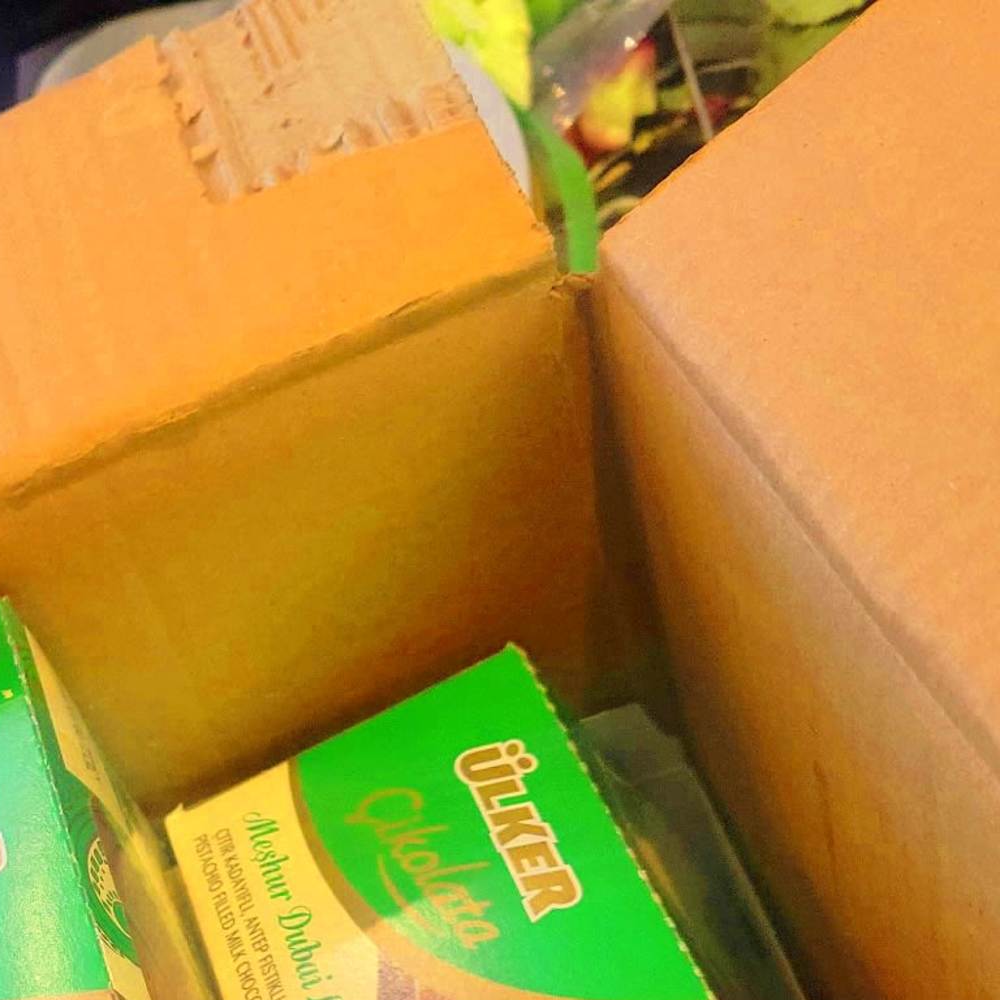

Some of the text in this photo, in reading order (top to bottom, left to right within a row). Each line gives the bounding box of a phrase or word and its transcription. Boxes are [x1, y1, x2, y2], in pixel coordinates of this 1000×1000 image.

[193, 833, 224, 893] PISTACHIO
[211, 891, 236, 932] FILLED
[224, 930, 248, 963] MILK
[242, 811, 293, 901] Meşhur
[277, 905, 334, 990] Dubai
[344, 787, 502, 951] Çikolata
[454, 738, 583, 924] ÜLKER
[244, 915, 270, 954] ANTEP
